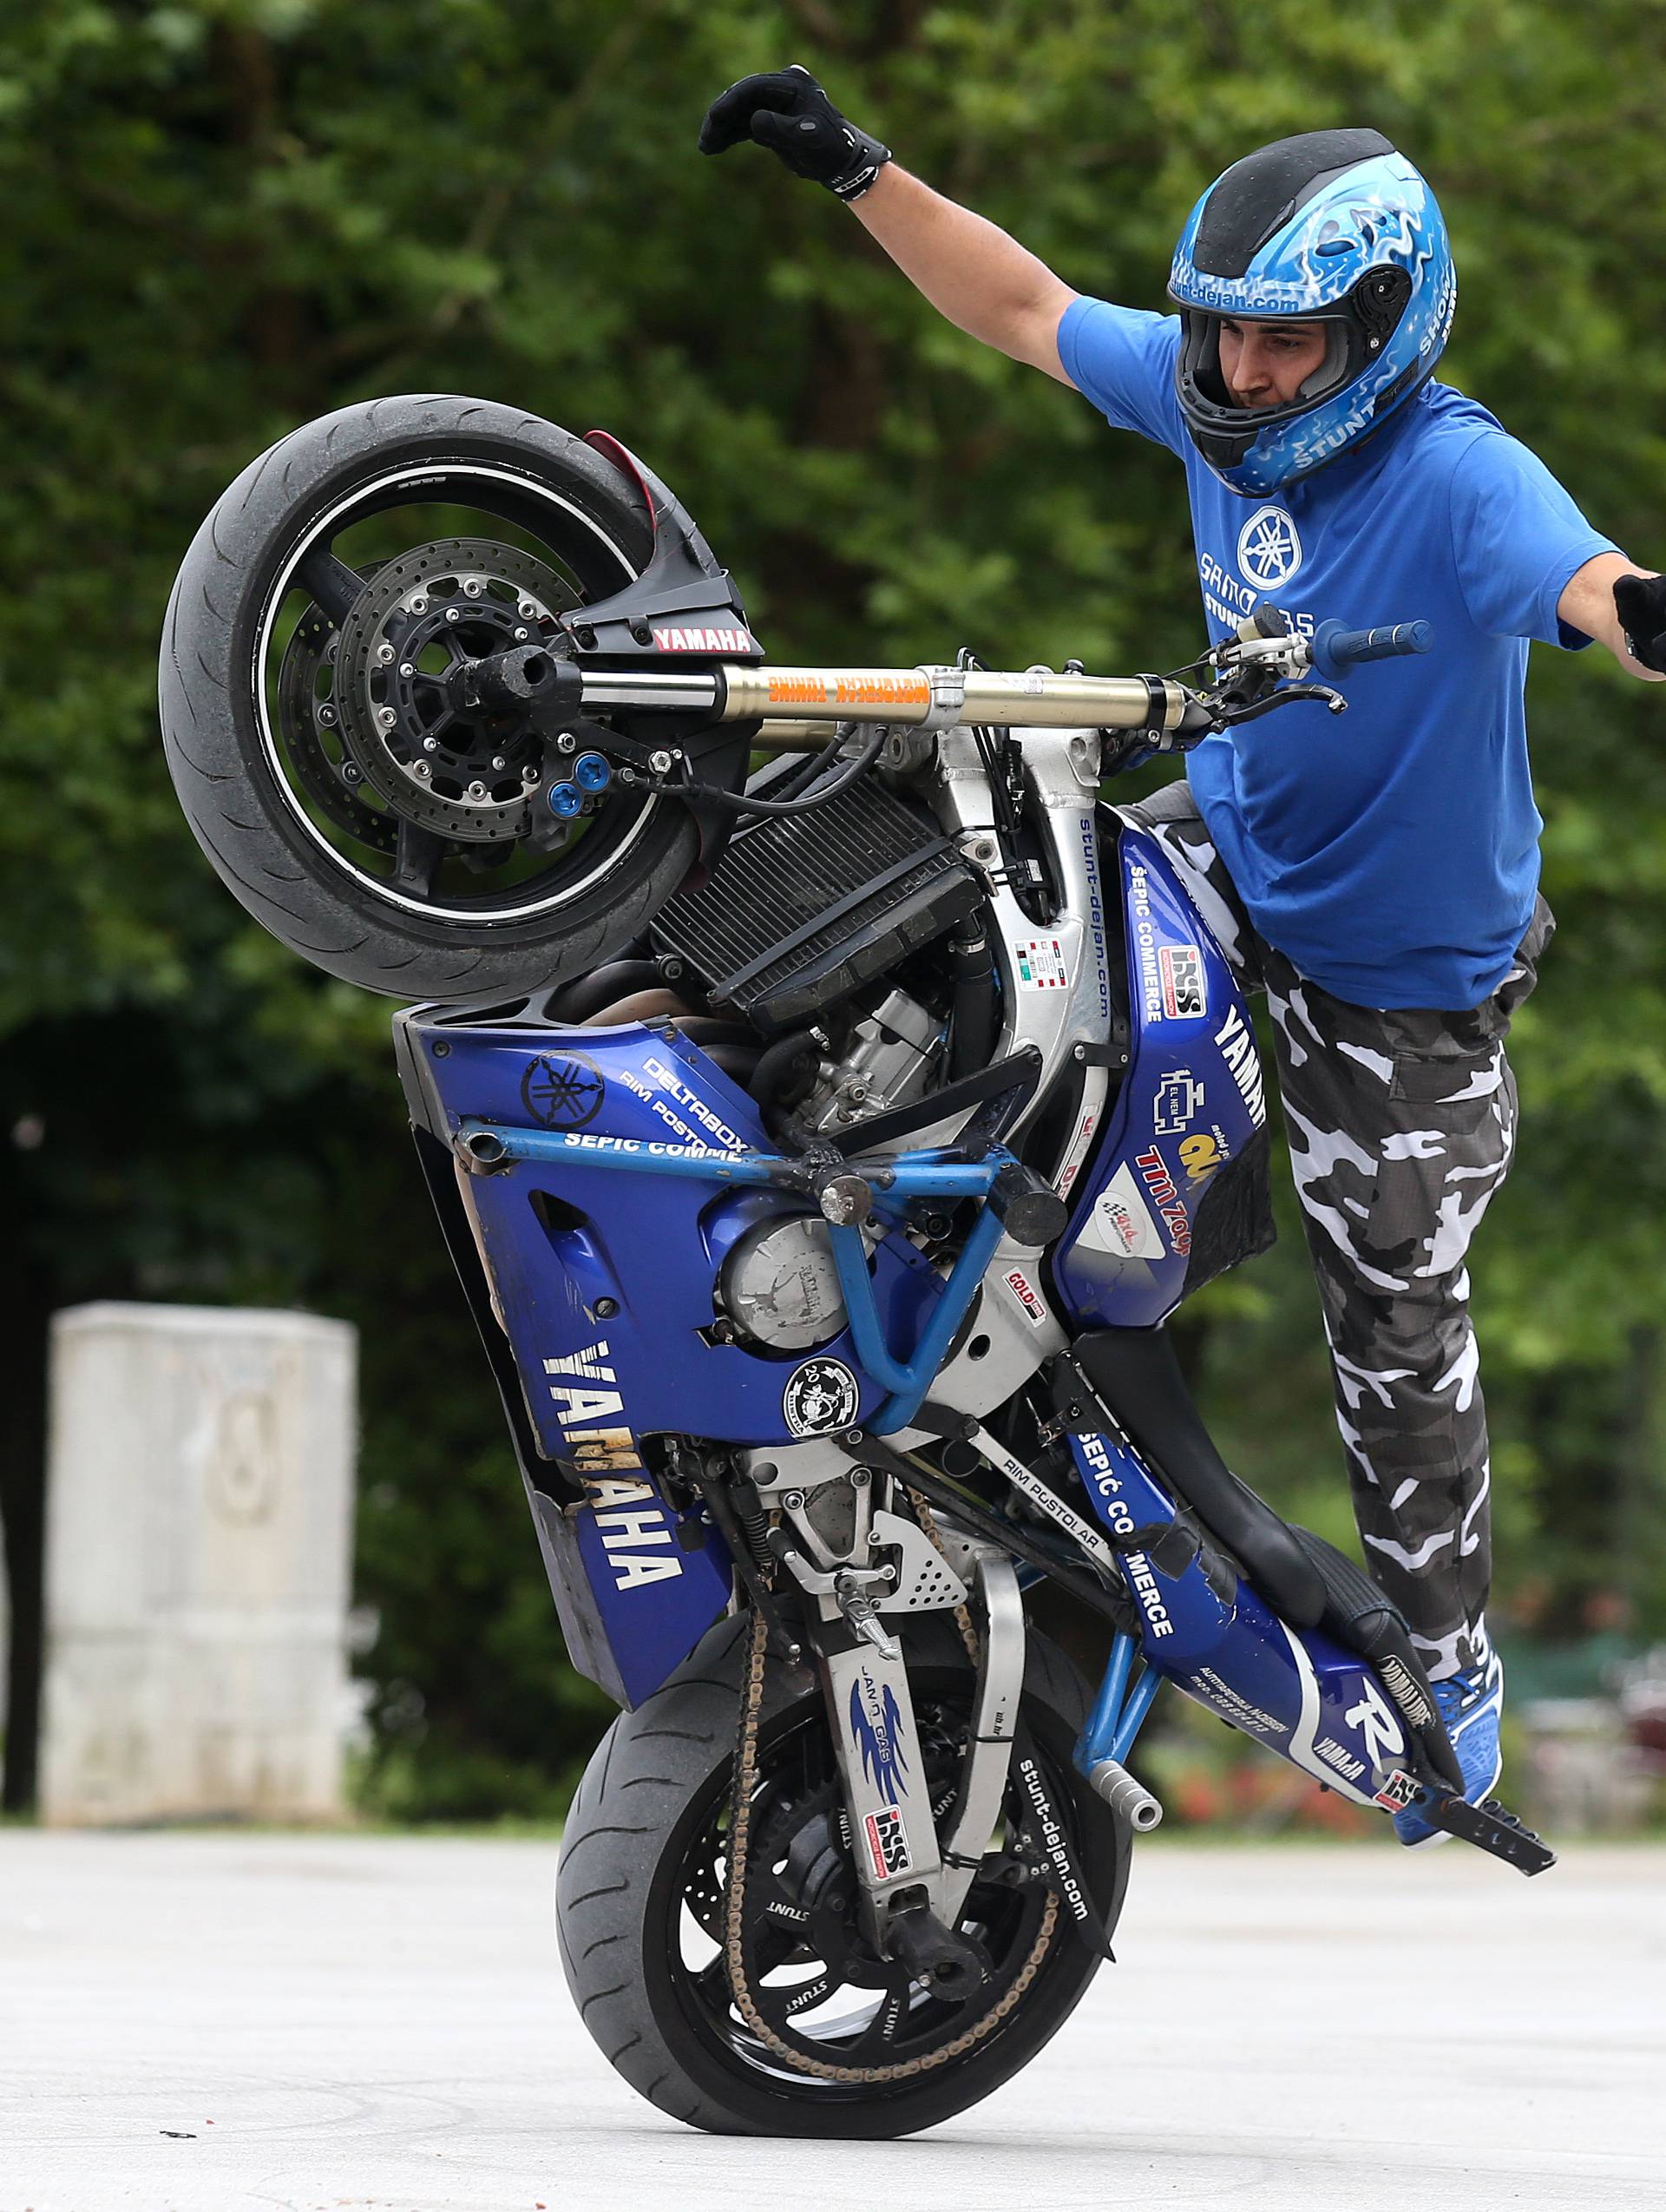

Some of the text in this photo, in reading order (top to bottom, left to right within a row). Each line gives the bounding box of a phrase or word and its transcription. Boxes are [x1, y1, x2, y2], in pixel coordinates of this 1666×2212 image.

[1171, 279, 1299, 312] stunt-dejan.com
[1420, 279, 1450, 357] SHOW
[1294, 398, 1376, 469] STUNT
[1200, 552, 1257, 615] SAMO
[653, 627, 751, 653] YAMAHA
[768, 675, 827, 703] TUNING
[1079, 817, 1109, 1019] stunt-dejan.com
[1136, 920, 1162, 1023] COMMERCE
[619, 1070, 653, 1103] RIM
[641, 1056, 750, 1154] DELTABOX
[1170, 1086, 1178, 1097] EL
[1008, 1271, 1034, 1304] GOLD
[543, 1341, 683, 1591] YAMAHA
[1003, 1460, 1030, 1485] RIM
[1381, 1659, 1433, 1729] YAMALUBE
[875, 1724, 891, 1762] GAS
[1344, 1677, 1406, 1772] R
[1020, 1758, 1089, 1921] stunt-dejan.com
[766, 1901, 810, 1921] STUNT
[786, 1980, 828, 2013] STUNT
